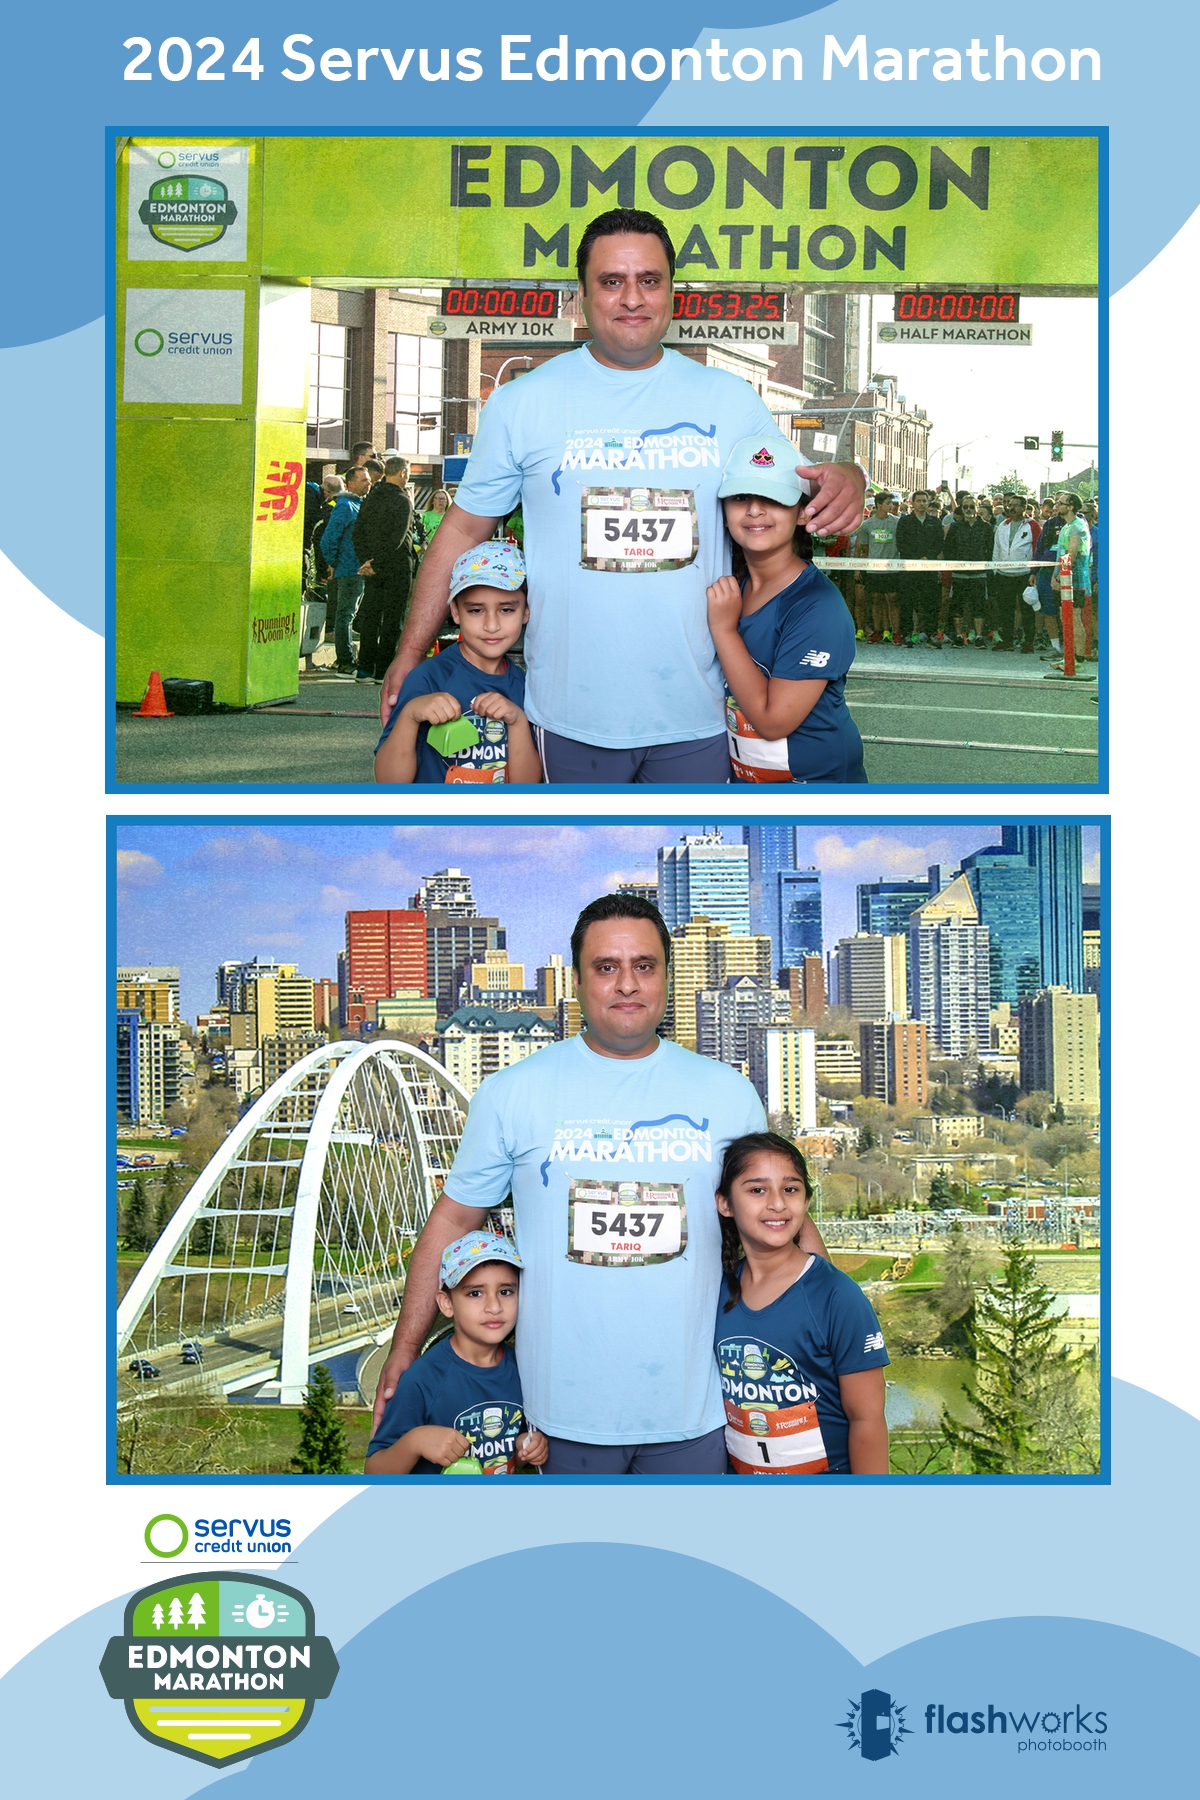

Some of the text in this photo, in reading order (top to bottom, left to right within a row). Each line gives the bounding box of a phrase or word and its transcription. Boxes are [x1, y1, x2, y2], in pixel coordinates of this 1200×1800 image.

[178, 152, 219, 161] servus
[451, 145, 990, 210] EDMONTON
[149, 202, 226, 213] EDMONTON
[160, 214, 215, 222] MARATHON
[523, 223, 906, 271] MATHON
[466, 321, 554, 336] ARMY 10K
[678, 325, 785, 340] MARATHON
[900, 328, 939, 340] HALF
[943, 328, 1031, 341] MARATHON
[168, 332, 233, 345] servus
[167, 345, 233, 355] credit union
[574, 428, 599, 436] servus
[565, 435, 719, 450] 2024 EDMONTON
[560, 447, 720, 471] MARATHON
[604, 517, 677, 543] 5437
[623, 547, 655, 557] TARIQ
[257, 613, 290, 635] Running
[554, 1127, 712, 1141] 2024 EDMONTON
[550, 1141, 712, 1162] MARATHON
[591, 1211, 664, 1237] 5437
[610, 1242, 642, 1252] TARIQ
[757, 1441, 771, 1464] 1
